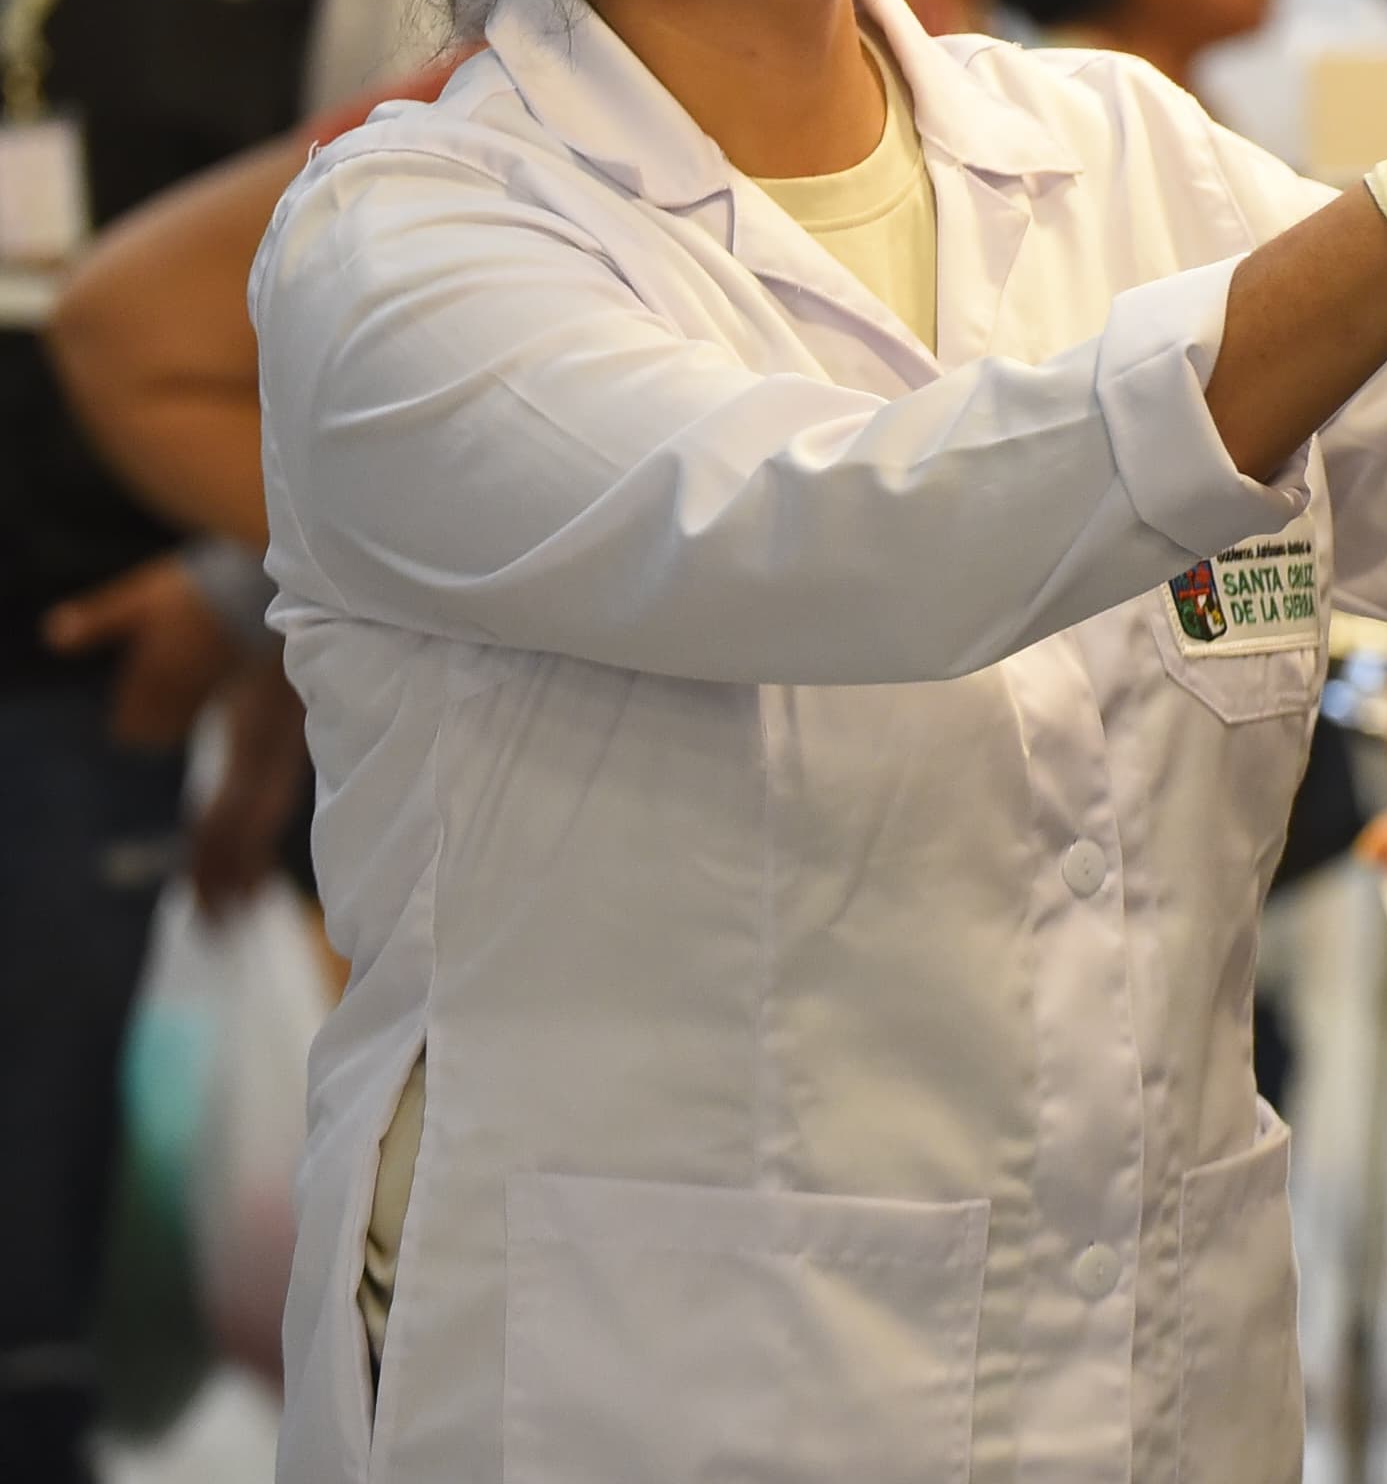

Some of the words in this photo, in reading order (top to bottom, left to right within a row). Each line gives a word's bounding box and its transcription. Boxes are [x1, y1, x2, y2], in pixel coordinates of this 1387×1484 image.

[1223, 566, 1283, 596] SANTA
[1230, 599, 1257, 624] DE
[1260, 596, 1280, 623] LA
